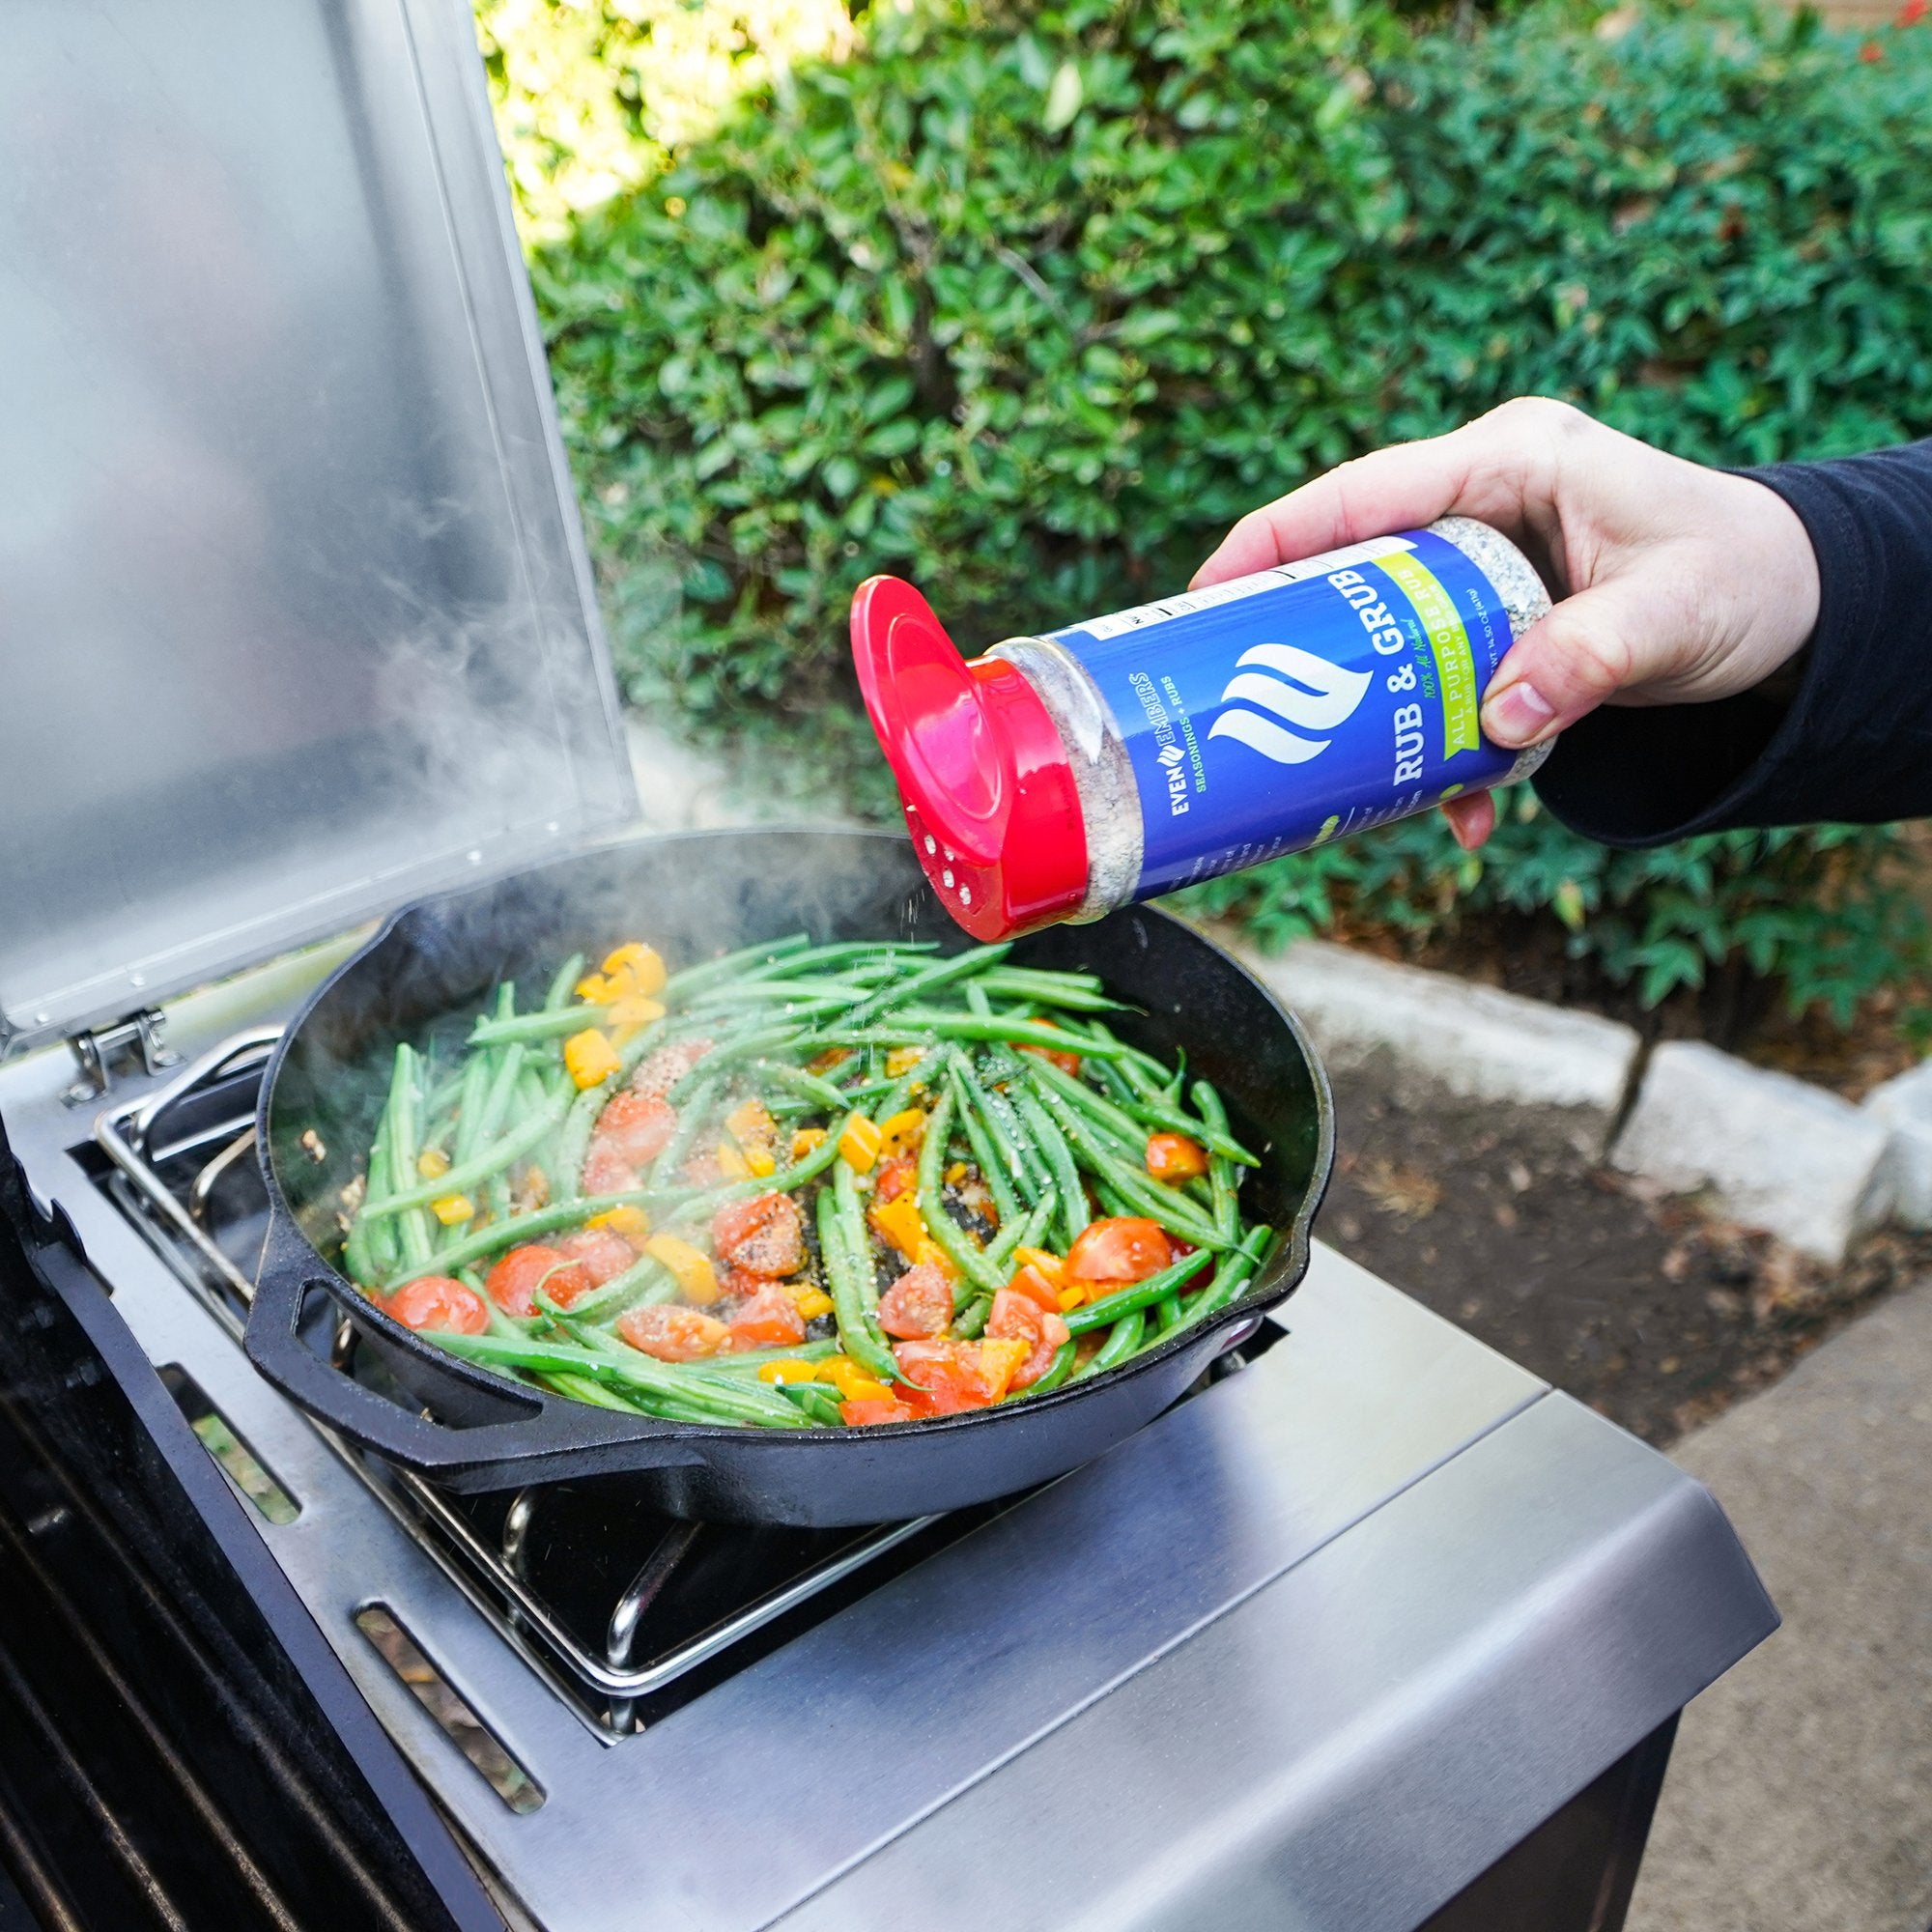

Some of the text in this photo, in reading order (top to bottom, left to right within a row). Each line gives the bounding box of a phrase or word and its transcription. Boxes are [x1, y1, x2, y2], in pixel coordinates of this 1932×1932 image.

[1327, 570, 1406, 656] GRUB
[1465, 588, 1485, 611] (411g)
[1478, 611, 1490, 624] OZ
[1455, 636, 1466, 656] ANY
[1483, 625, 1495, 648] 14.50
[1397, 569, 1465, 745] ALL PURPOSE RUB
[1400, 618, 1435, 698] 100% All Natural
[1461, 660, 1471, 682] FOR
[1160, 675, 1183, 706] RUBS
[1386, 663, 1417, 693] &
[1463, 684, 1472, 705] RUB
[1128, 672, 1190, 816] EVEN EMBERS
[1179, 716, 1207, 793] SEASONINGS
[1393, 702, 1424, 786] RUB
